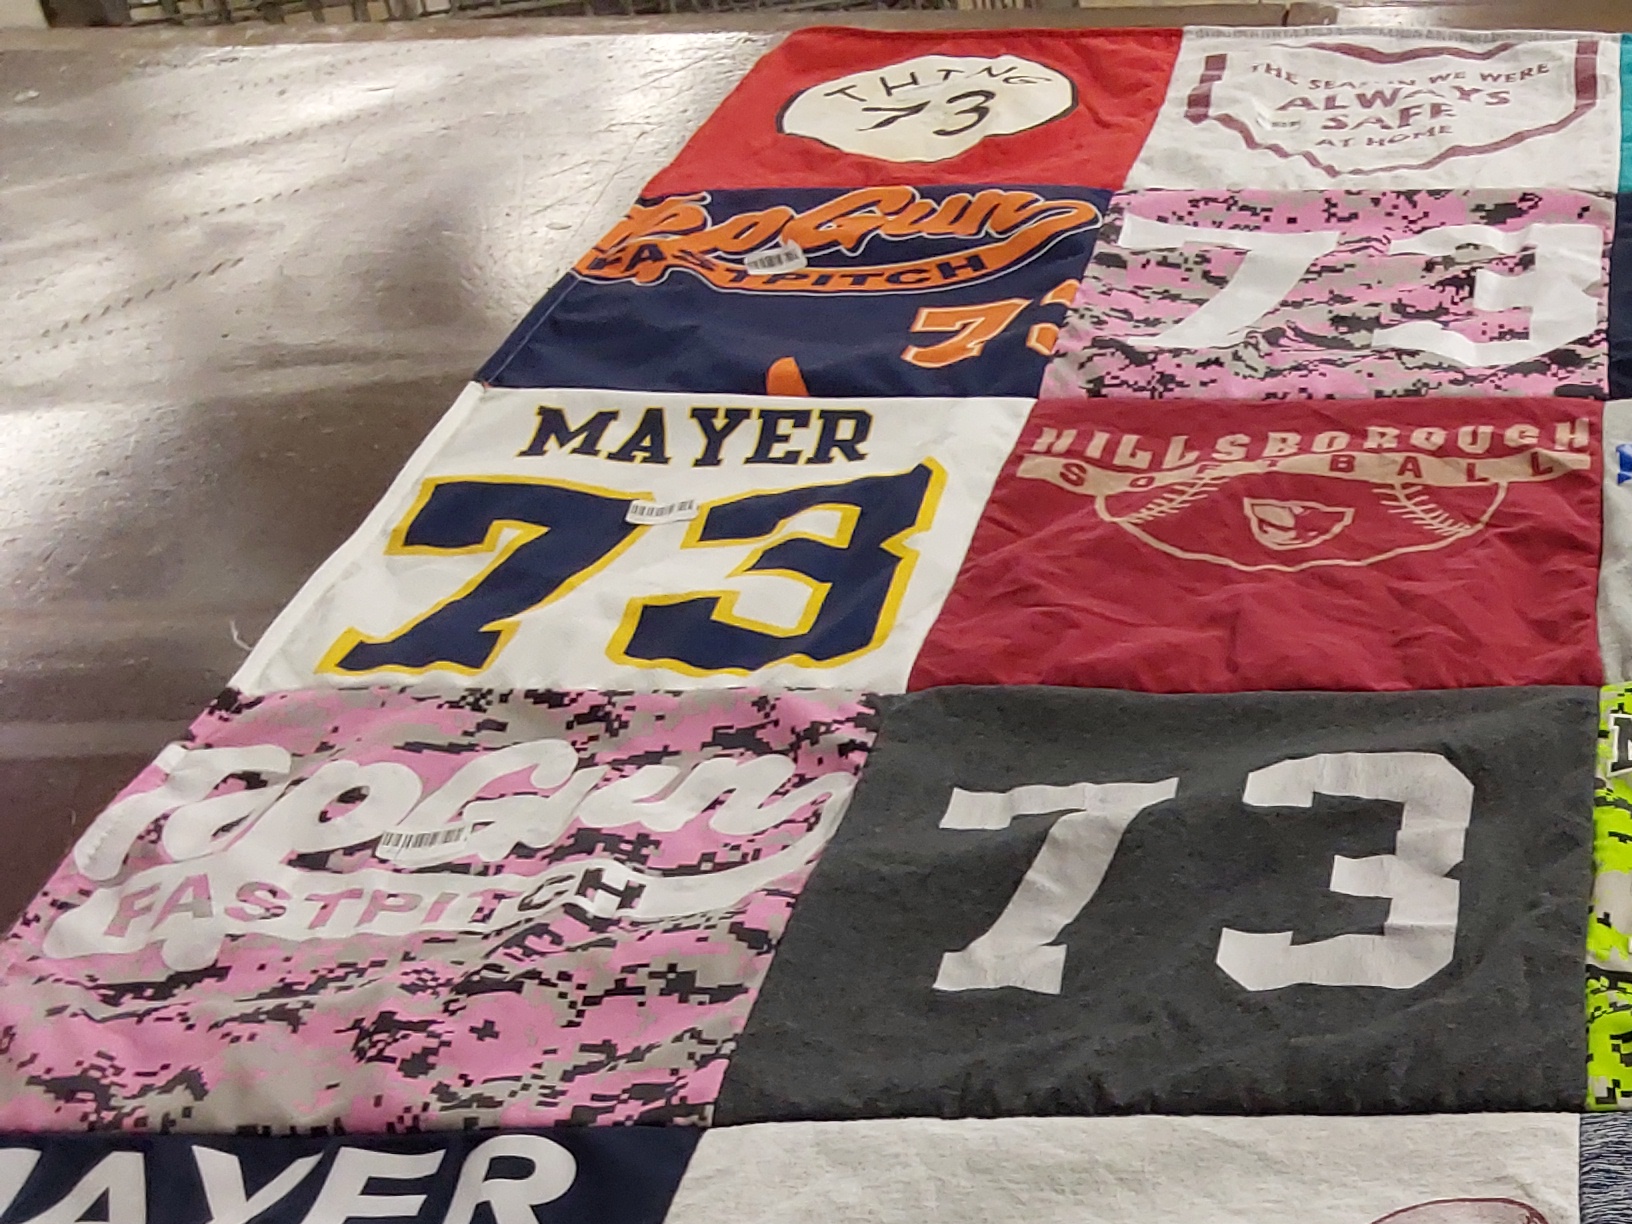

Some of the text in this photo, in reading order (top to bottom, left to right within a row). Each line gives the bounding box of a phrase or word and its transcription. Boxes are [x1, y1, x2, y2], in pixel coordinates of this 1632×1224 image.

[823, 65, 1052, 102] THING
[1250, 63, 1298, 85] THE
[1429, 71, 1466, 84] WE
[1479, 63, 1550, 83] WERE
[1275, 85, 1511, 111] ALWAYS
[857, 89, 997, 136] 73
[1314, 125, 1453, 147] AT HOME
[1321, 102, 1456, 130] SAFE
[1118, 213, 1602, 367] 73
[518, 406, 873, 467] MAYER
[1032, 417, 1591, 469] HILLSBOROUGH
[314, 456, 947, 677] 73
[933, 751, 1475, 994] 73
[102, 859, 646, 938] FASTPITCH
